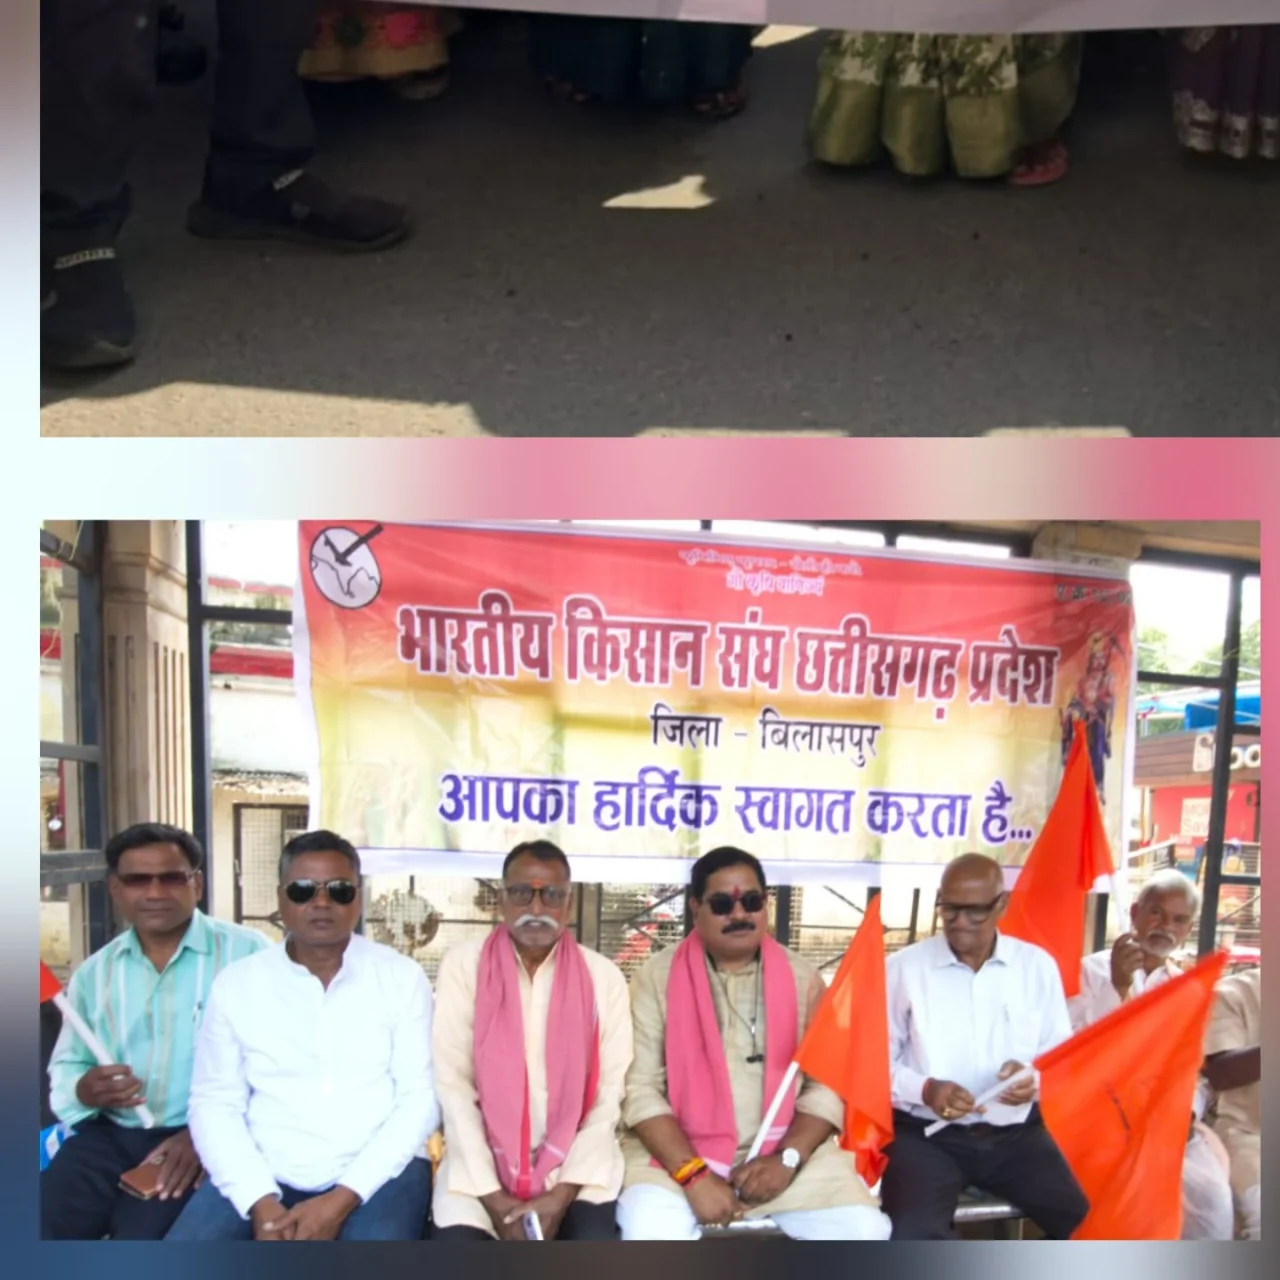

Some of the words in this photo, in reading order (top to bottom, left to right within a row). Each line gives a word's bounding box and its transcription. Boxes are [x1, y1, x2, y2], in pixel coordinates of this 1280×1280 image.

[397, 589, 555, 681] भारतीय
[565, 595, 709, 688] किसान
[717, 608, 788, 690] संघ
[794, 613, 964, 721] छत्तीसगढ़
[967, 625, 1060, 706] प्रदेश
[651, 703, 722, 748] जिला
[758, 708, 882, 768] बिलासपुर
[438, 773, 580, 825] आपका
[593, 766, 719, 833] हार्दिक
[734, 785, 856, 837] स्वागत
[867, 790, 972, 839] करता
